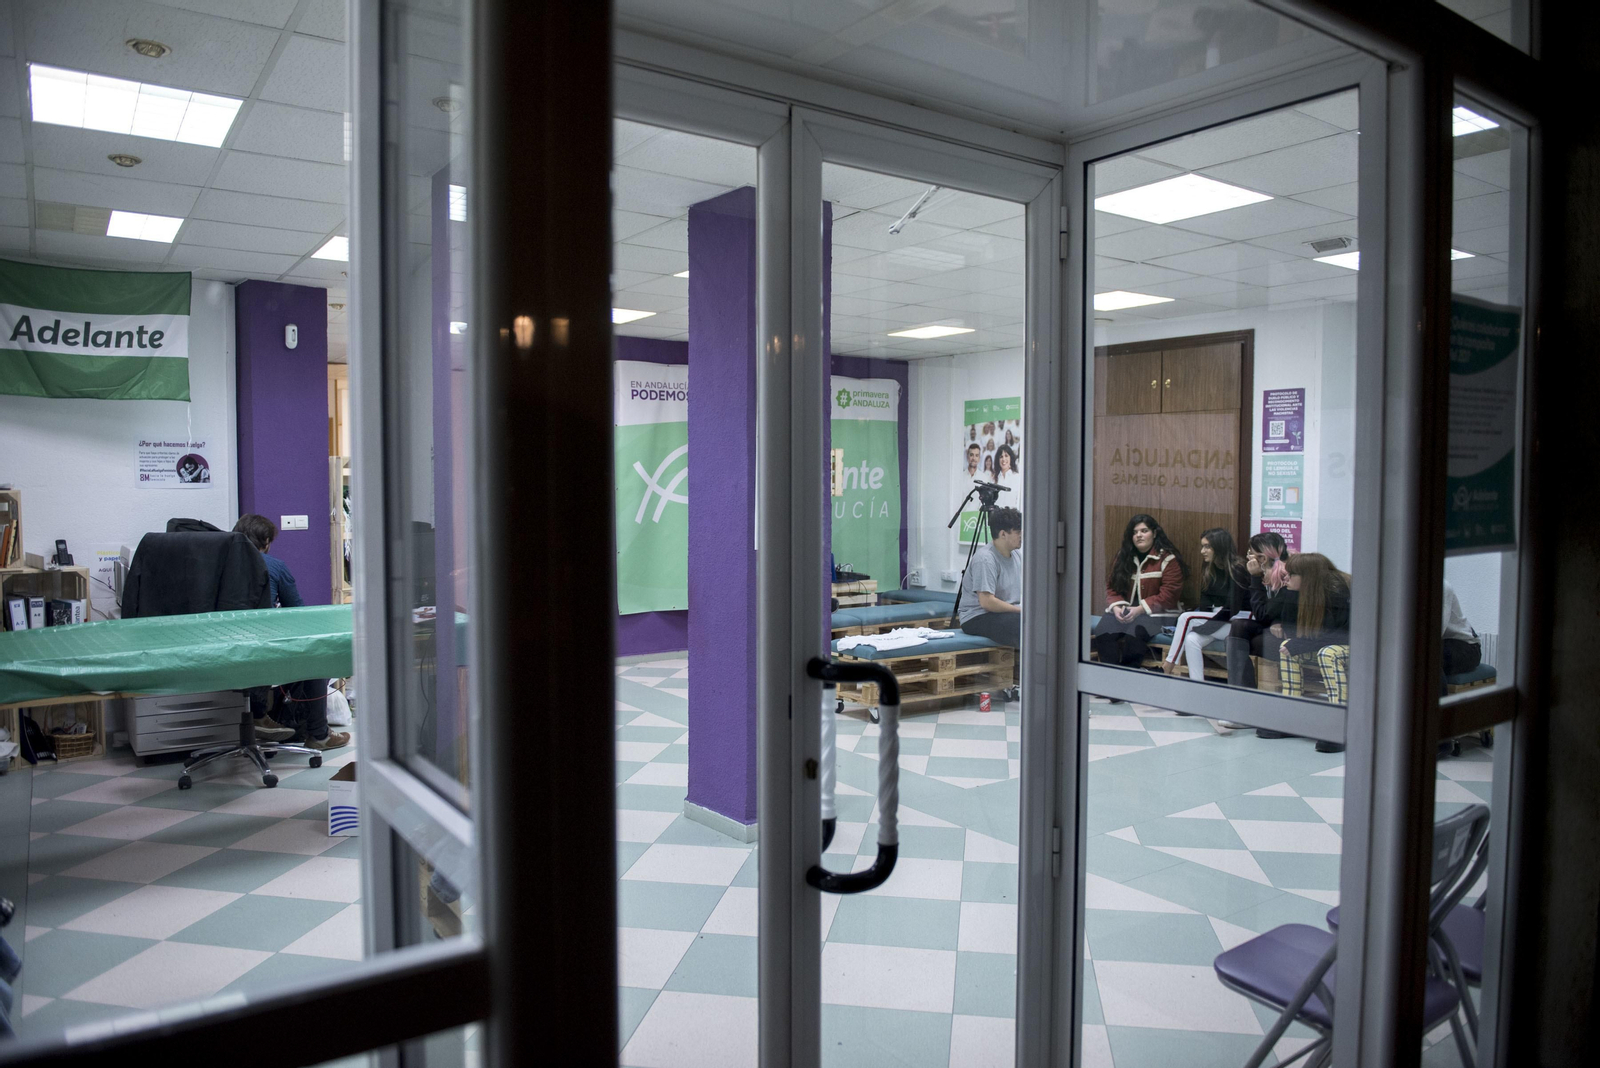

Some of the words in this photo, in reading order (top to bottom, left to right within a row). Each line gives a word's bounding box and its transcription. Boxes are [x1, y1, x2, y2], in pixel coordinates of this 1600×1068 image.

[9, 315, 165, 349] Adelante
[644, 381, 689, 390] ANDALUCÍ
[853, 389, 890, 399] primavera
[853, 400, 890, 409] ANDALUZA
[842, 460, 885, 490] nte
[834, 496, 889, 519] UCÍA
